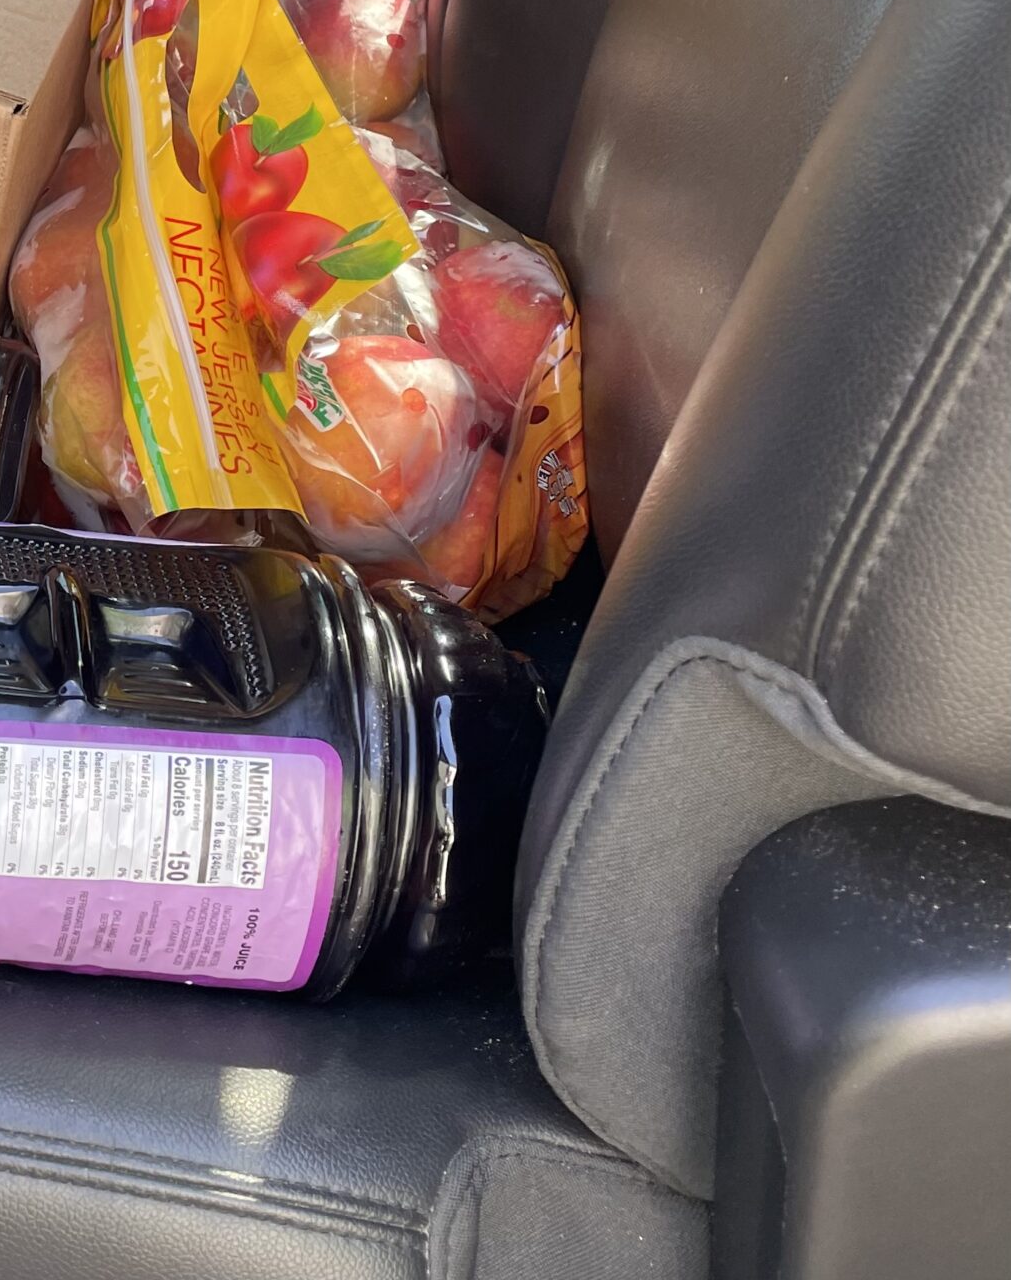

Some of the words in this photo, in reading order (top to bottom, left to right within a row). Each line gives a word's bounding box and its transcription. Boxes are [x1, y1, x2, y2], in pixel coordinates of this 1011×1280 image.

[208, 248, 228, 333] NEW
[212, 341, 264, 461] JERSEY
[537, 465, 552, 491] NET
[45, 757, 55, 779] Dietary
[63, 750, 71, 769] Total
[78, 750, 87, 779] Sodium
[110, 761, 118, 778] Trans
[142, 754, 150, 773] Total
[232, 759, 241, 782] About
[14, 763, 22, 790] Includes
[92, 751, 103, 795] Cholesterol
[124, 761, 133, 791] Saturated
[194, 757, 202, 786] Amount
[215, 758, 226, 791] Serving
[28, 774, 38, 796] Sugars
[45, 781, 54, 797] Fiber
[75, 780, 85, 798] 20mg
[108, 780, 117, 789] Fat
[172, 756, 190, 816] Calories
[192, 789, 200, 800] per
[58, 771, 70, 822] Carbohydrate
[91, 797, 99, 811] 0mg
[124, 793, 132, 802] Fat
[216, 793, 224, 810] size
[229, 790, 239, 822] servings
[245, 761, 269, 836] Nutrition
[12, 801, 20, 821] Added
[191, 803, 200, 831] serving
[9, 823, 18, 844] Sugars
[215, 828, 223, 837] fl.
[227, 824, 236, 837] per
[150, 843, 159, 859] Daily
[226, 838, 236, 871] container
[7, 862, 16, 872] 0%
[39, 864, 46, 874] 0%
[70, 866, 79, 875] 1%
[87, 866, 94, 876] 0%
[118, 867, 126, 877] 0%
[133, 869, 142, 879] 0%
[167, 850, 189, 881] 150
[209, 852, 221, 884] (240mL)
[240, 841, 263, 885] Facts
[243, 907, 260, 939] 100%
[233, 942, 251, 970] JUICE
